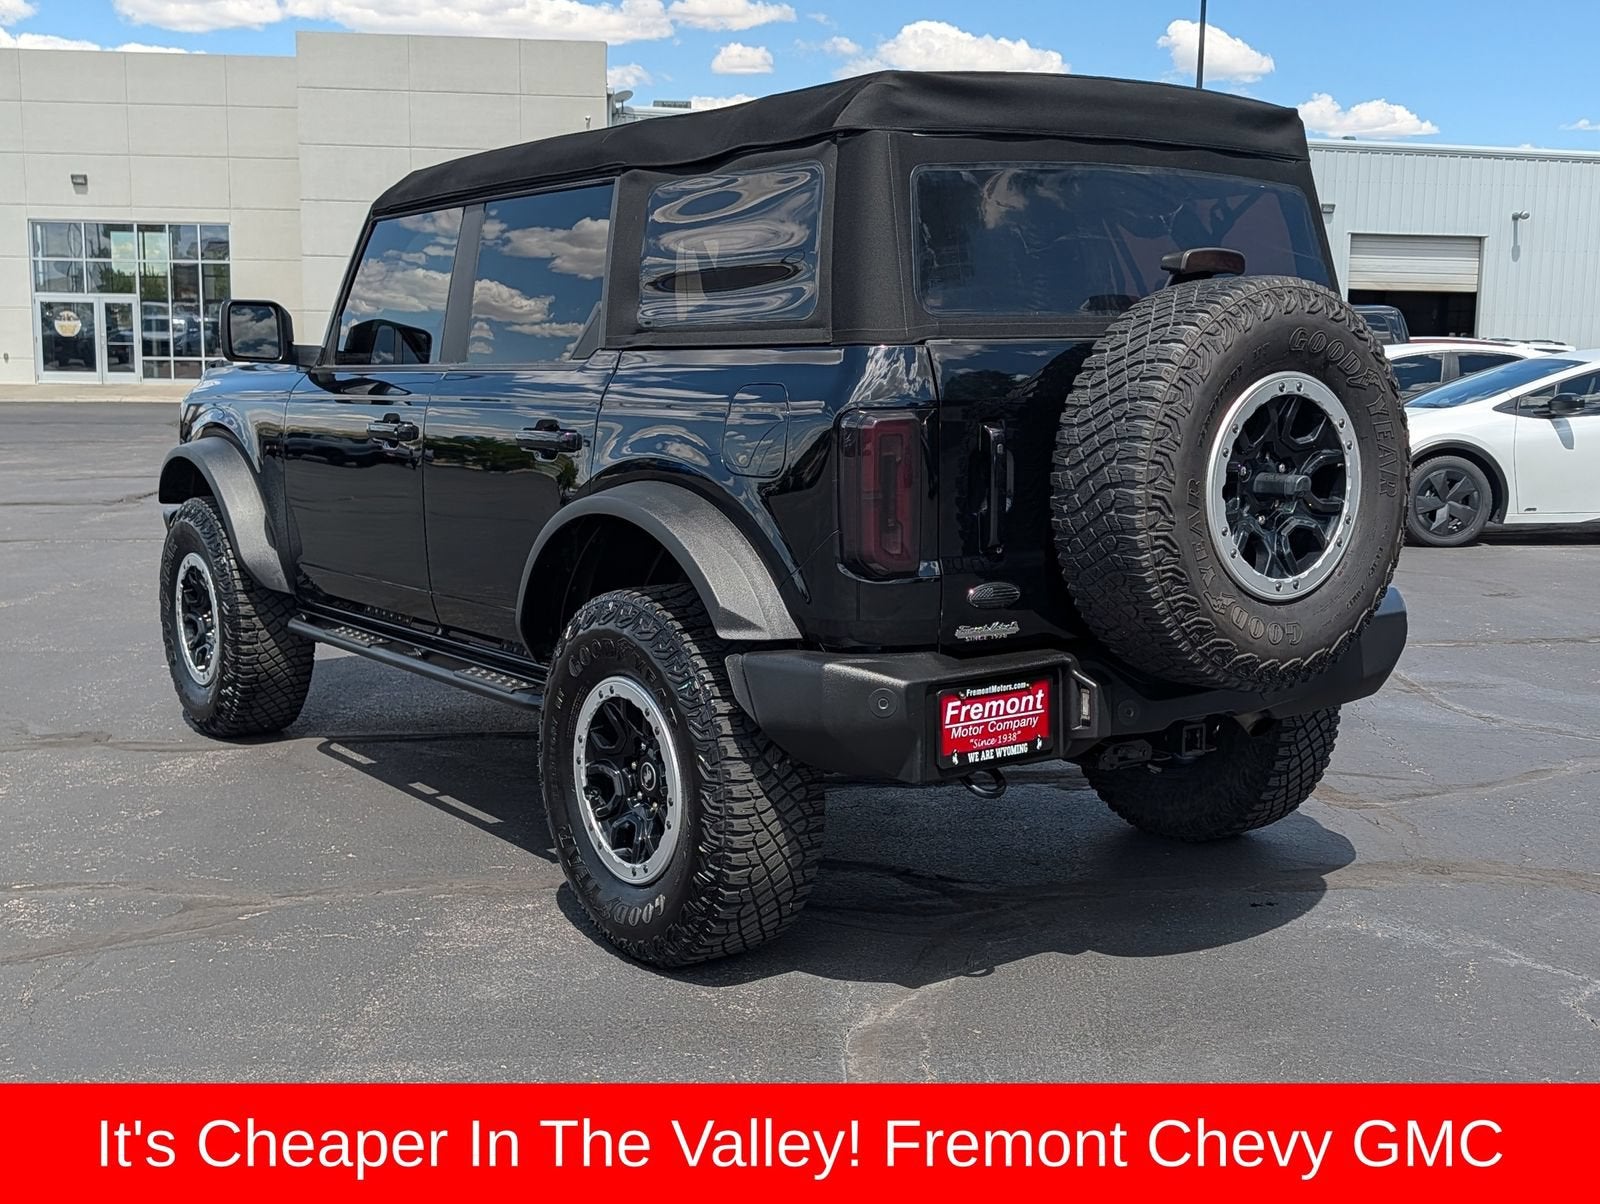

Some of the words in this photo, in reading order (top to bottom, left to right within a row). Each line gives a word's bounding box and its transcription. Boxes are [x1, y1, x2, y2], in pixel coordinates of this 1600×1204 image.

[1288, 327, 1398, 499] GOODYEAR
[1187, 478, 1303, 646] GOODYEAR
[966, 682, 1027, 697] FremontMotors.com
[945, 689, 1044, 724] Fremont
[950, 724, 984, 739] Motor
[988, 716, 1039, 733] Company
[967, 752, 979, 763] WE
[980, 749, 994, 761] ARE
[995, 743, 1028, 758] WYOMING
